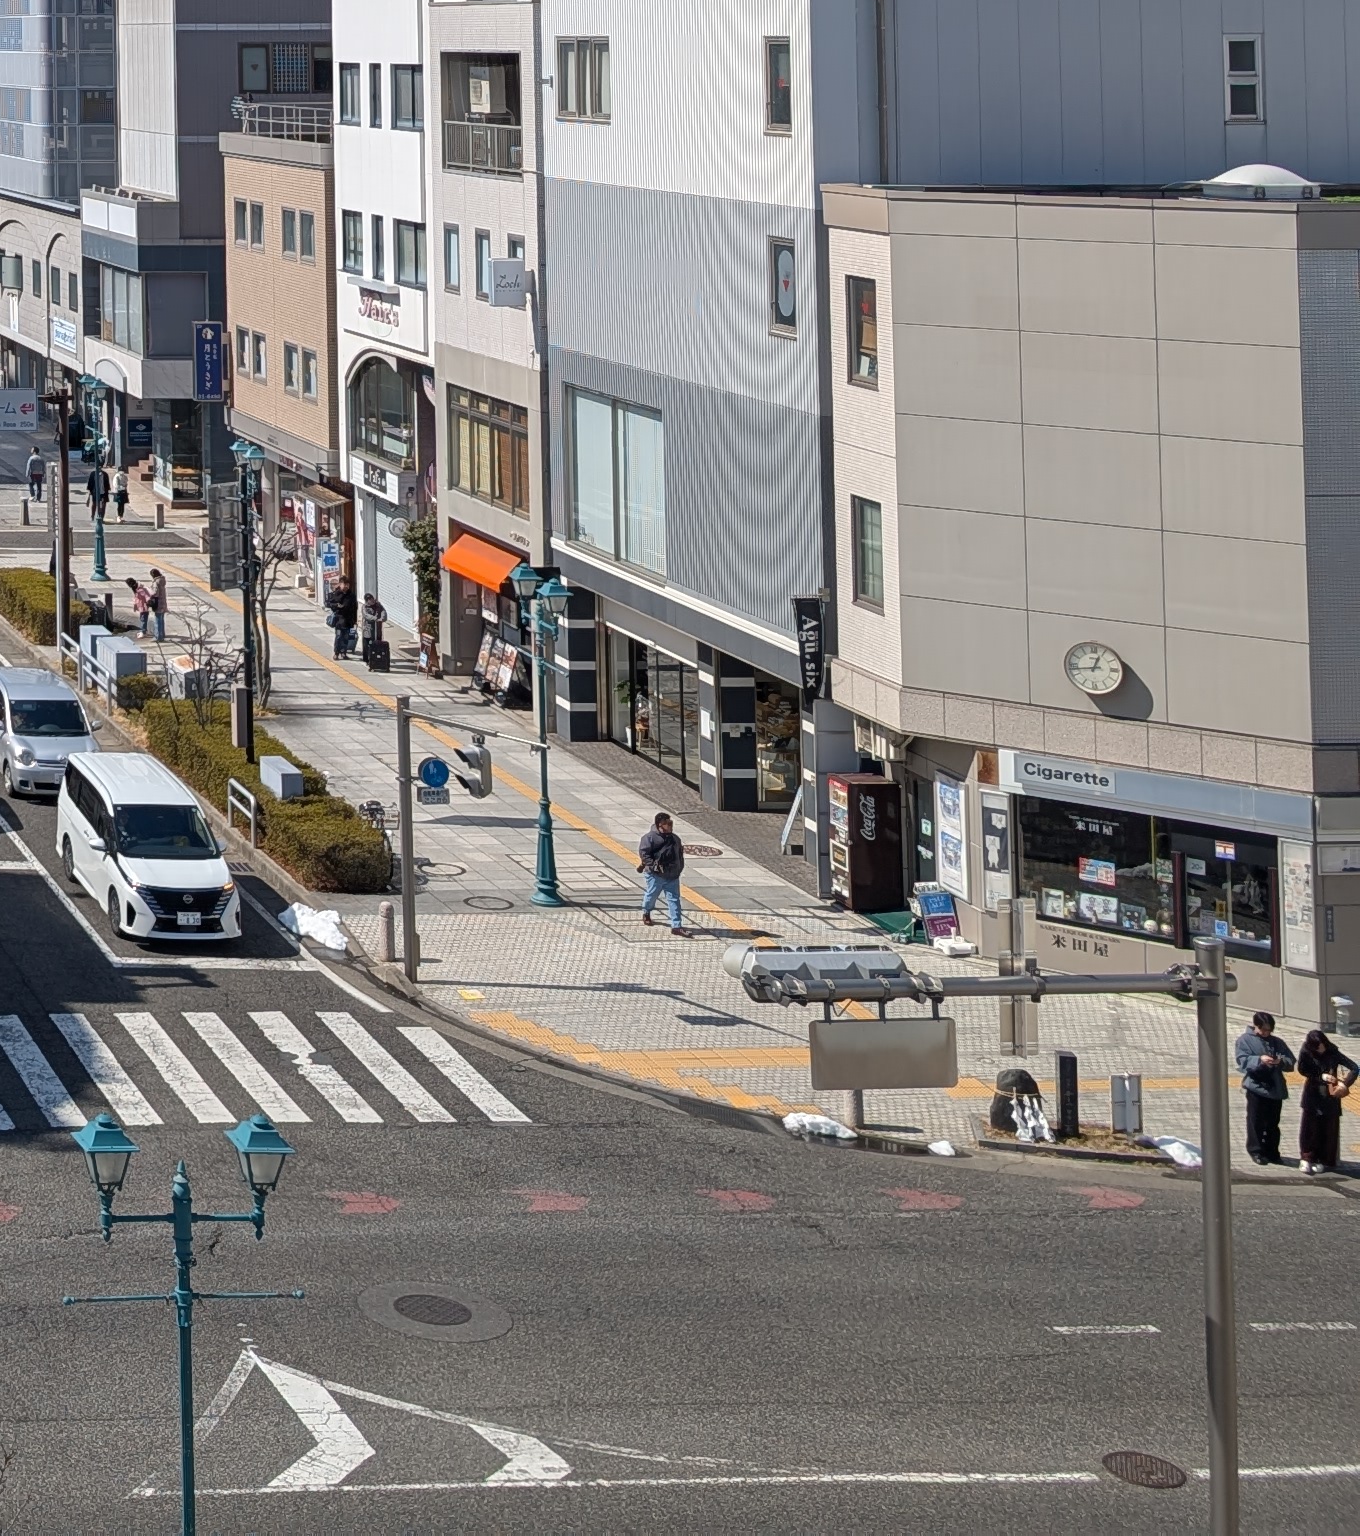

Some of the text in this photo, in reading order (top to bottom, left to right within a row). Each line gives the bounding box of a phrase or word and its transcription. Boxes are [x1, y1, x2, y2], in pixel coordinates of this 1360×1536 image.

[805, 662, 820, 689] six
[1023, 762, 1110, 787] Cigarette
[1052, 933, 1109, 958] 米田屋
